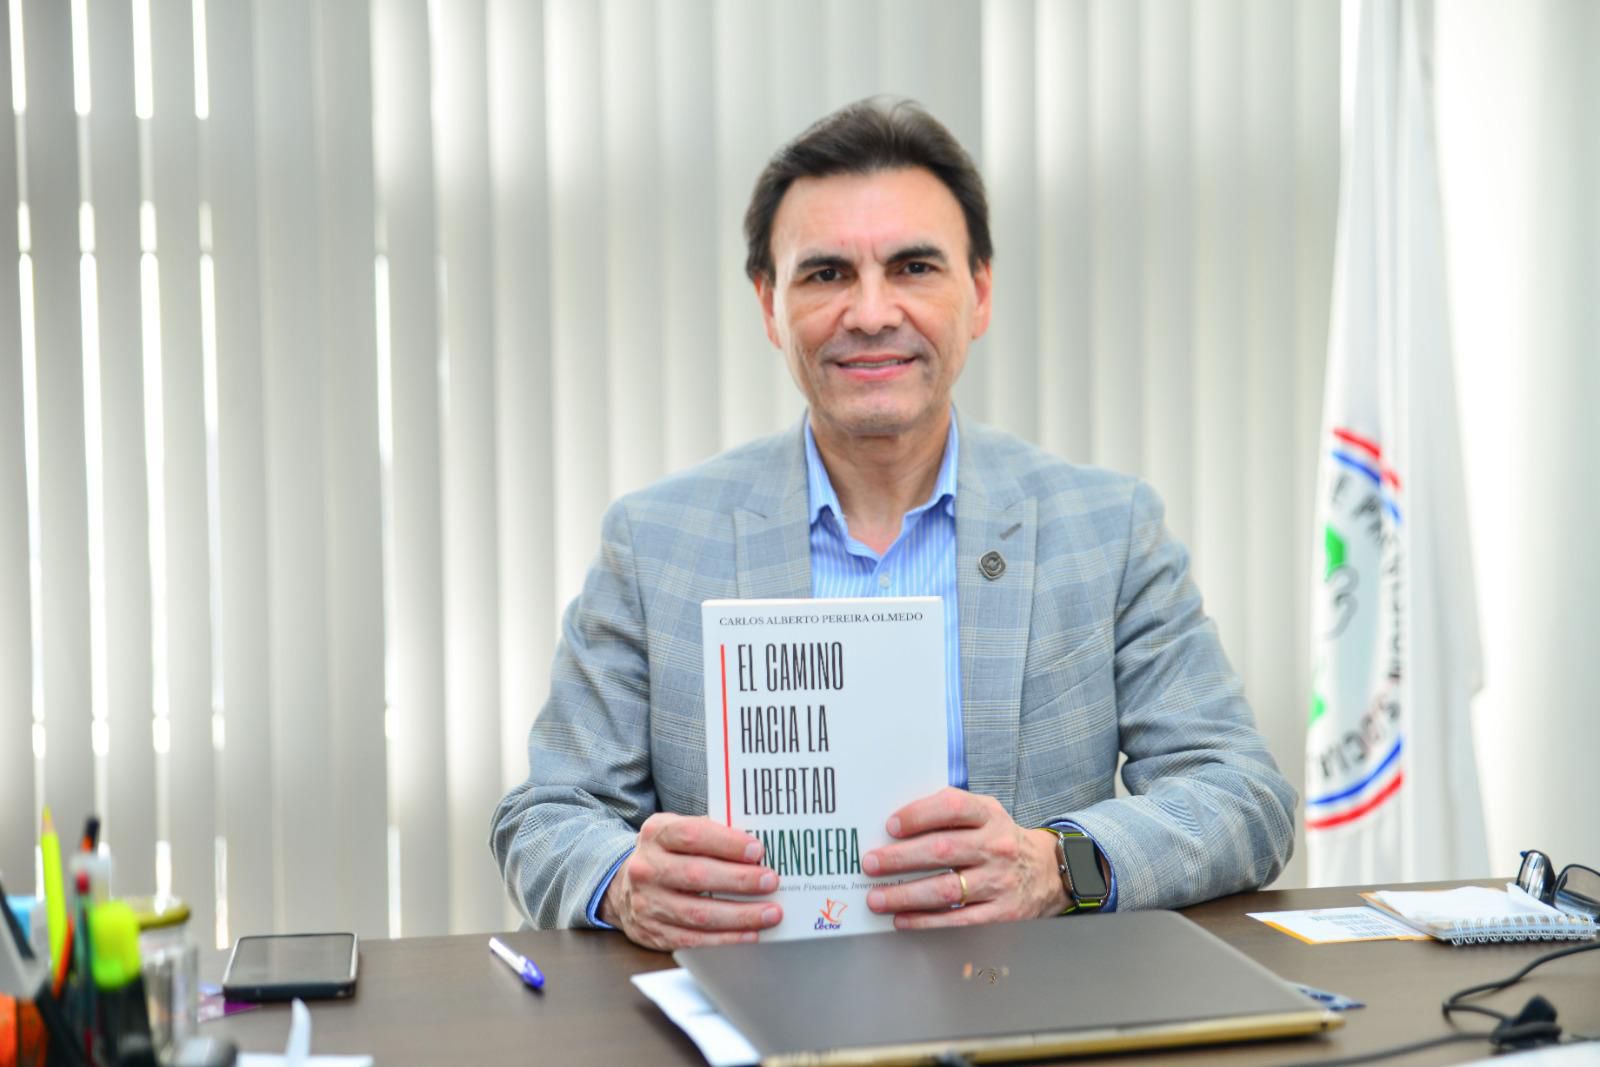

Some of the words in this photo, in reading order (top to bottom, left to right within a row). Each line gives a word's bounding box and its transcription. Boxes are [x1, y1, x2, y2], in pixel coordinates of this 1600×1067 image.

[719, 616, 764, 626] CARLOS
[766, 614, 819, 626] ALBERTO
[821, 613, 869, 624] PEREIRA
[871, 611, 923, 622] OLMEDO
[737, 643, 758, 692] EL
[765, 641, 844, 692] CAMINO
[740, 705, 800, 753] HACIA
[807, 704, 830, 752] LA
[742, 766, 836, 815] LIBERTAD
[745, 828, 862, 877] NANCIERA
[814, 922, 841, 930] Lector
